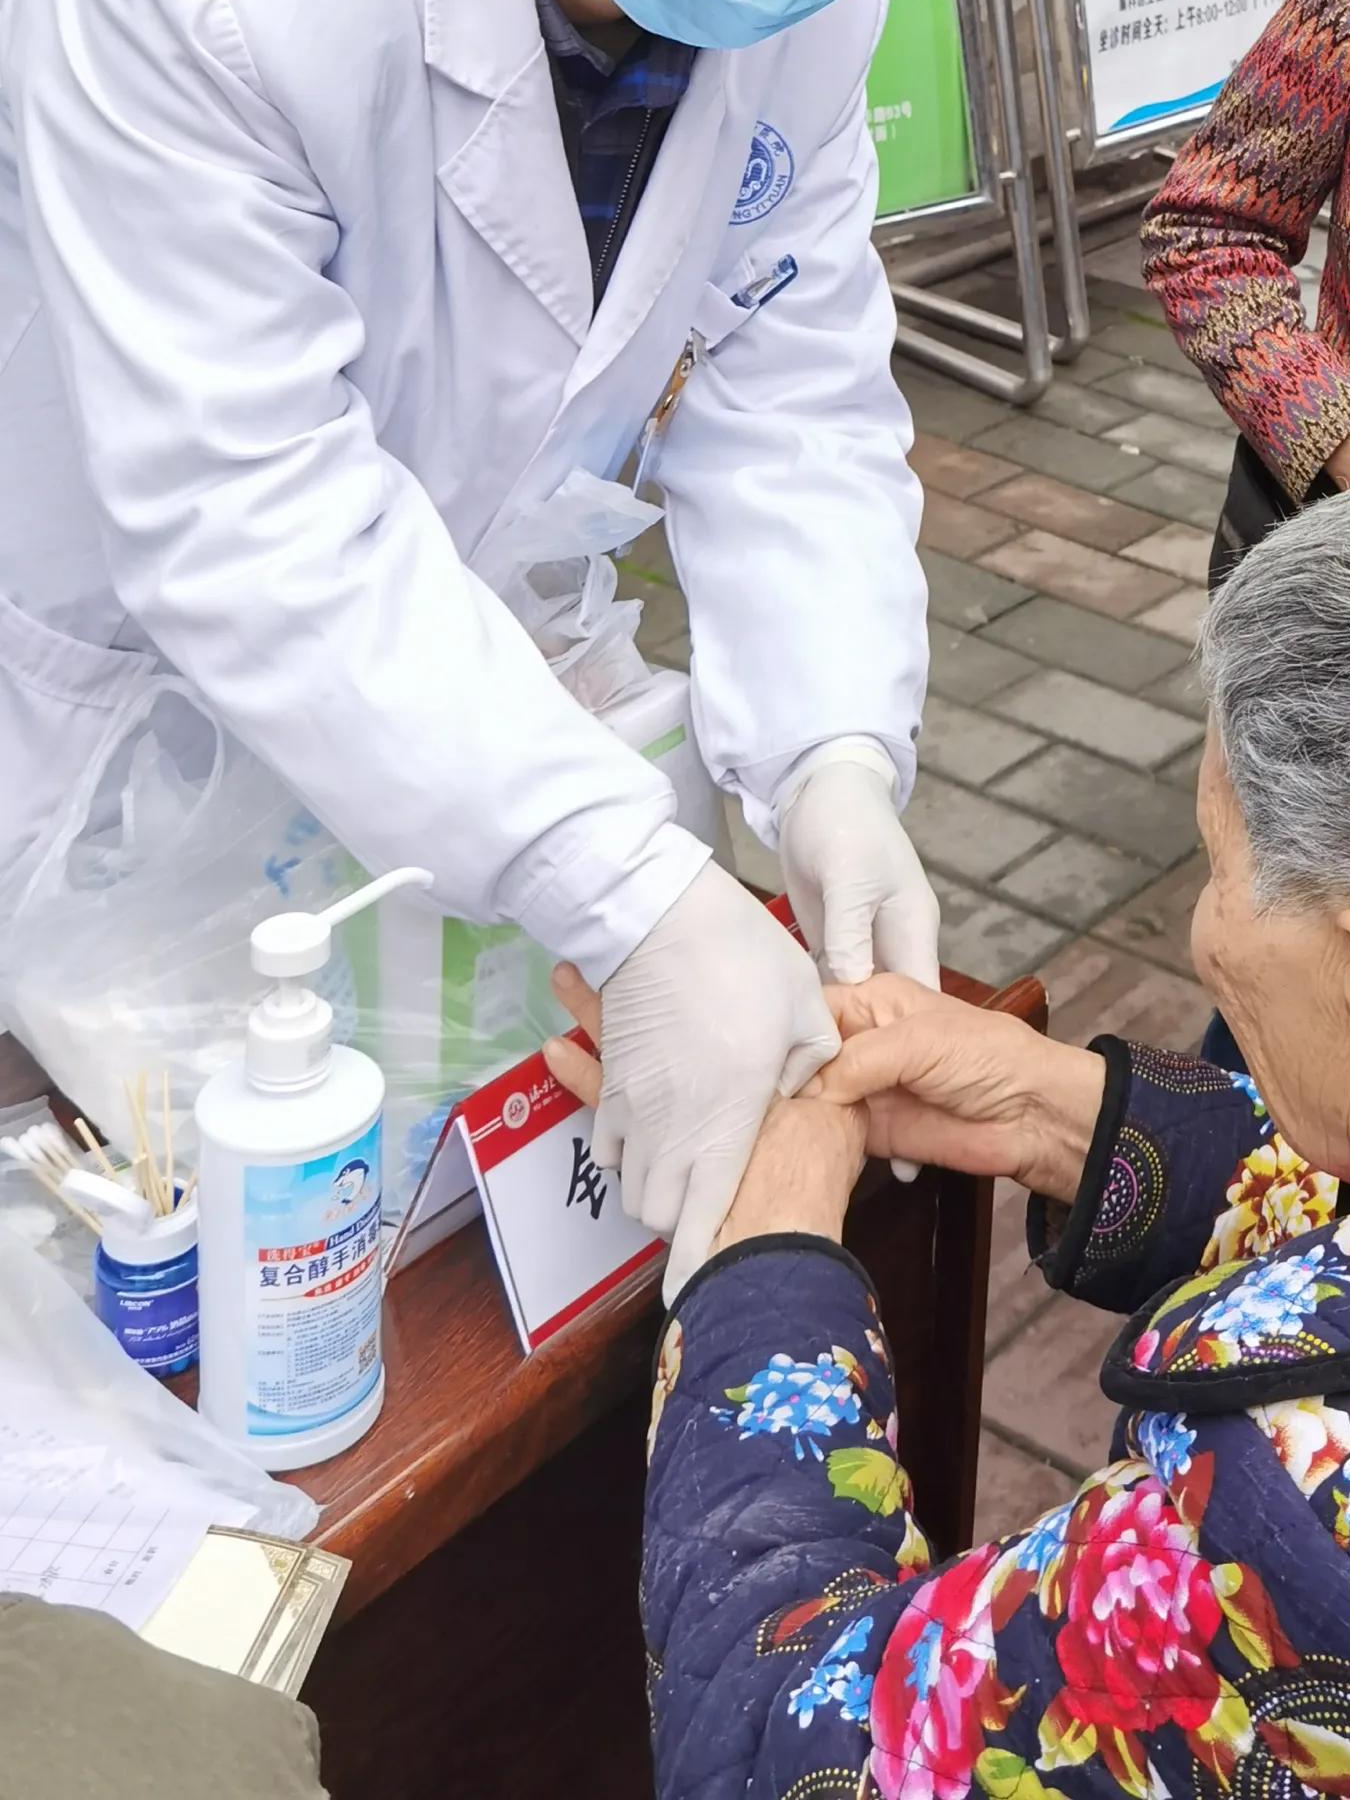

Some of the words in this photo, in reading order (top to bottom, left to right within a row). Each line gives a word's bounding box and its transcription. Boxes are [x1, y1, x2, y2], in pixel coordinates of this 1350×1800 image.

[259, 1218, 380, 1288] 复合醇手消毒
